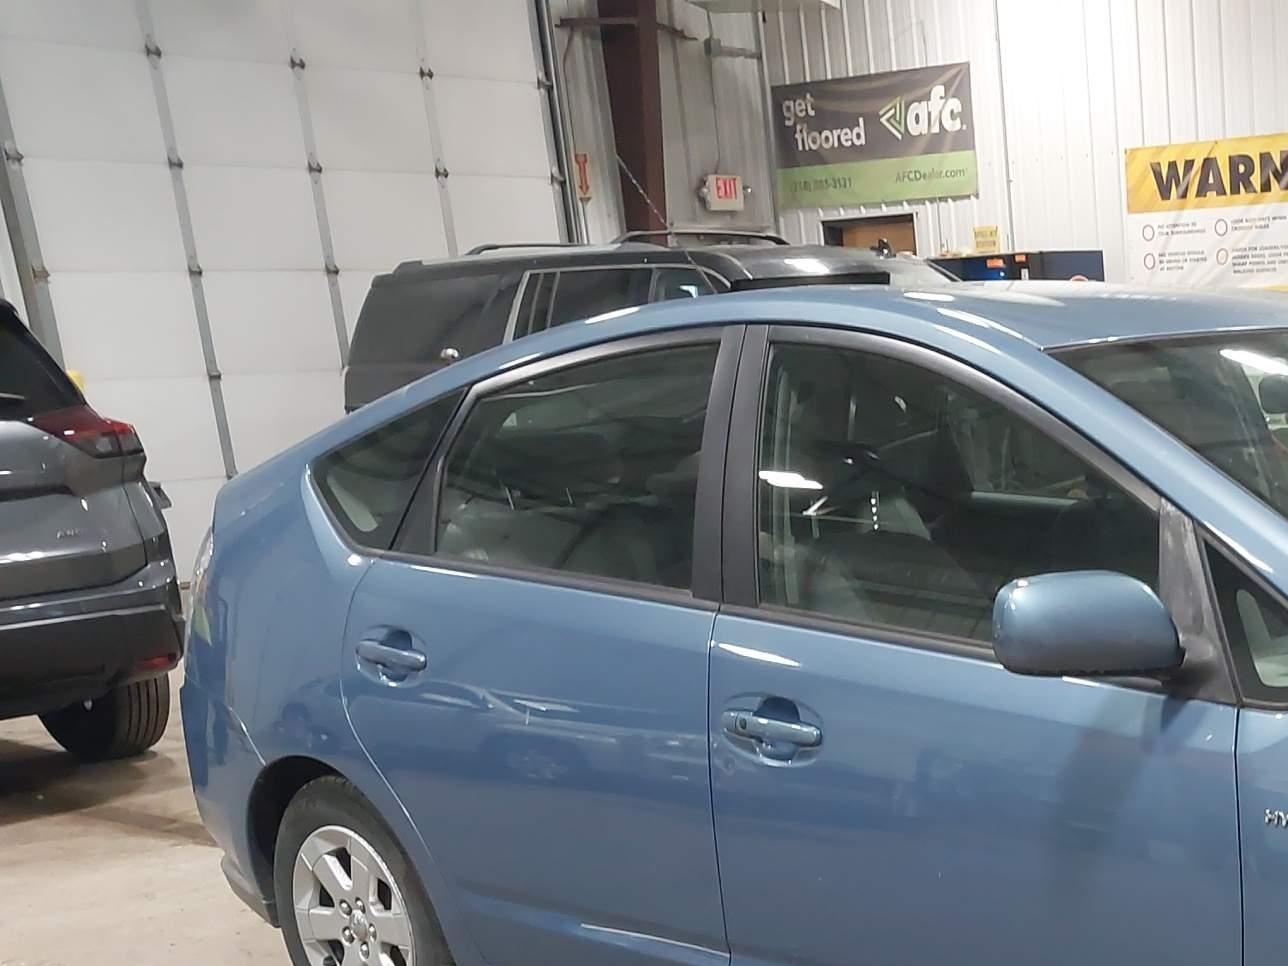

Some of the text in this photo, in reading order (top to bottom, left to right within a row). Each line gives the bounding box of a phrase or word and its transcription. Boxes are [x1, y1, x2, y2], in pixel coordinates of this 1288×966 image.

[782, 93, 815, 127] get
[906, 85, 962, 137] afc
[795, 117, 866, 151] floored
[716, 176, 738, 200] EXIT
